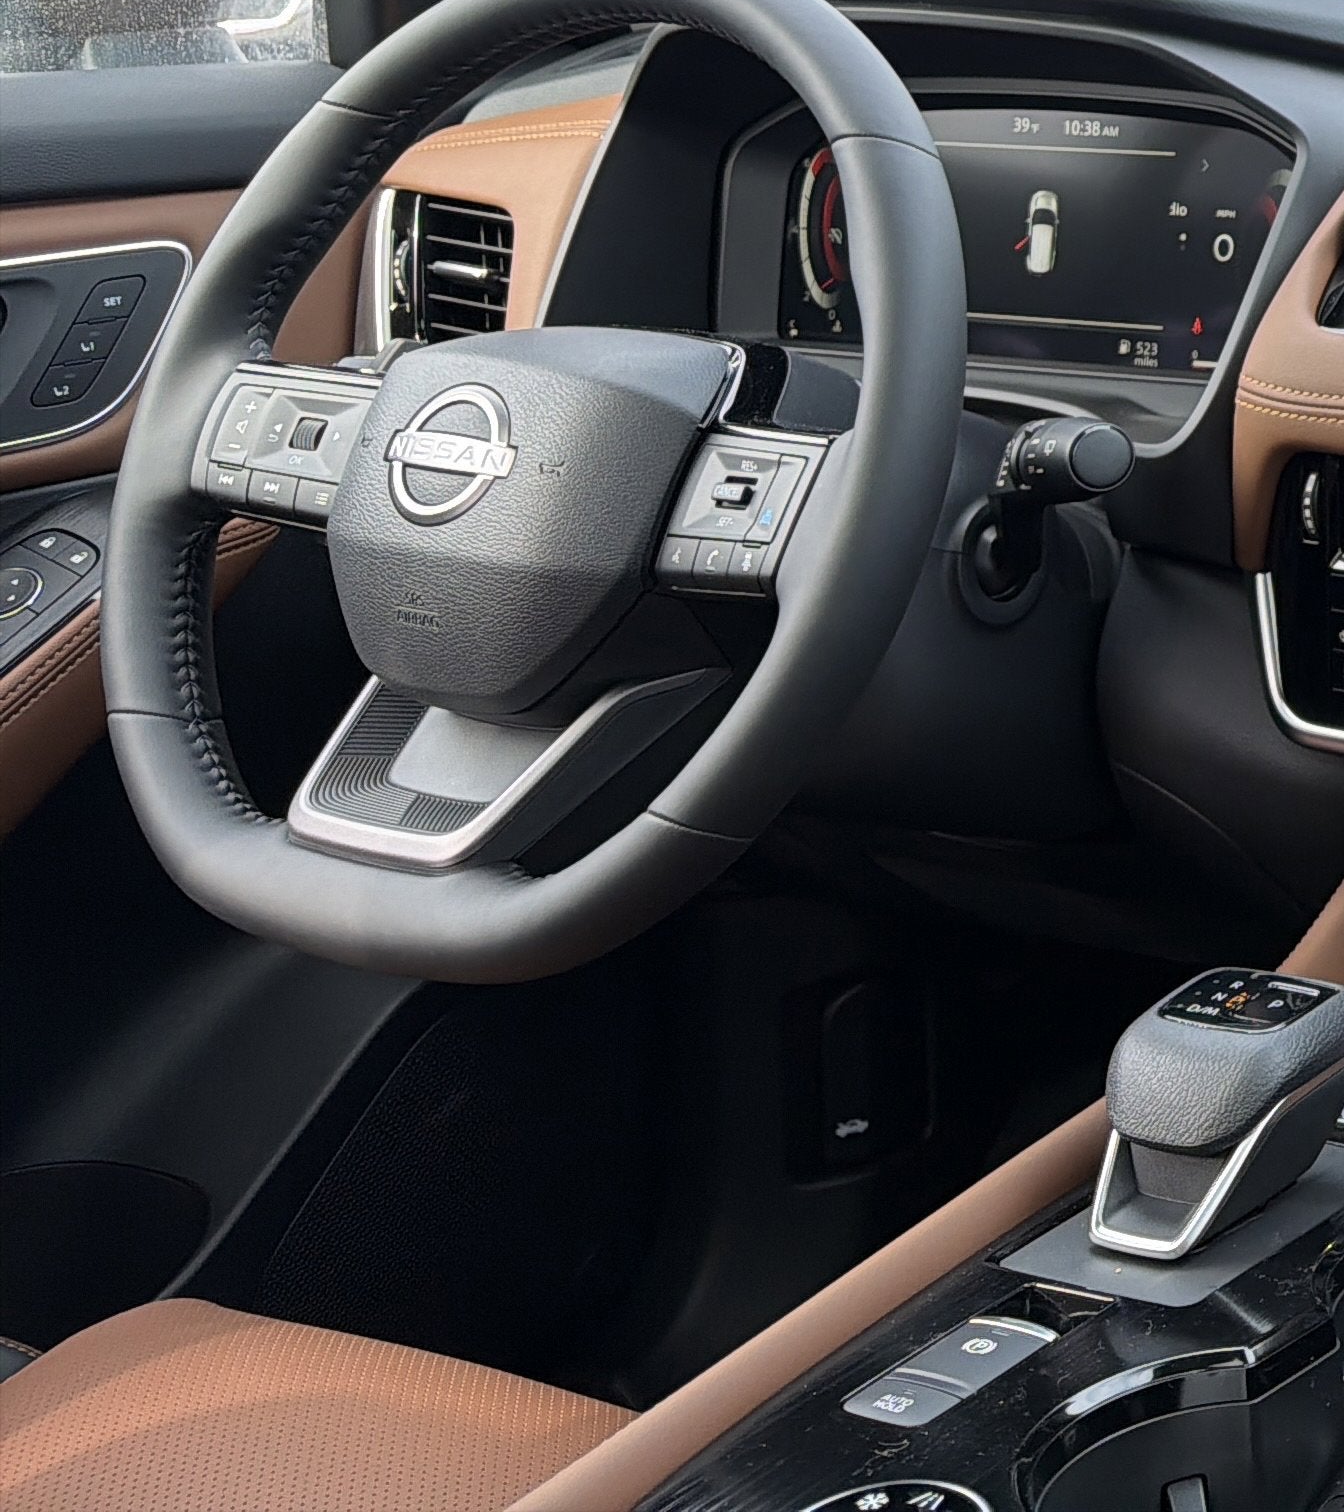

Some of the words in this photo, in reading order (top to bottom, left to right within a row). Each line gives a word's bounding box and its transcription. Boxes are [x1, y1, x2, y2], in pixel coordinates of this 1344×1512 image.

[1064, 120, 1101, 137] 10:38
[1101, 126, 1120, 138] AM
[1213, 233, 1235, 263] 0
[103, 295, 123, 307] SET
[1135, 341, 1159, 357] 523
[1134, 356, 1159, 368] miles
[388, 434, 508, 471] NISSAN
[1229, 980, 1244, 989] R
[1211, 992, 1228, 1002] N
[1186, 1003, 1220, 1016] D/M
[1267, 999, 1284, 1009] P
[881, 1393, 914, 1406] AUTO
[872, 1399, 906, 1414] HOLD
